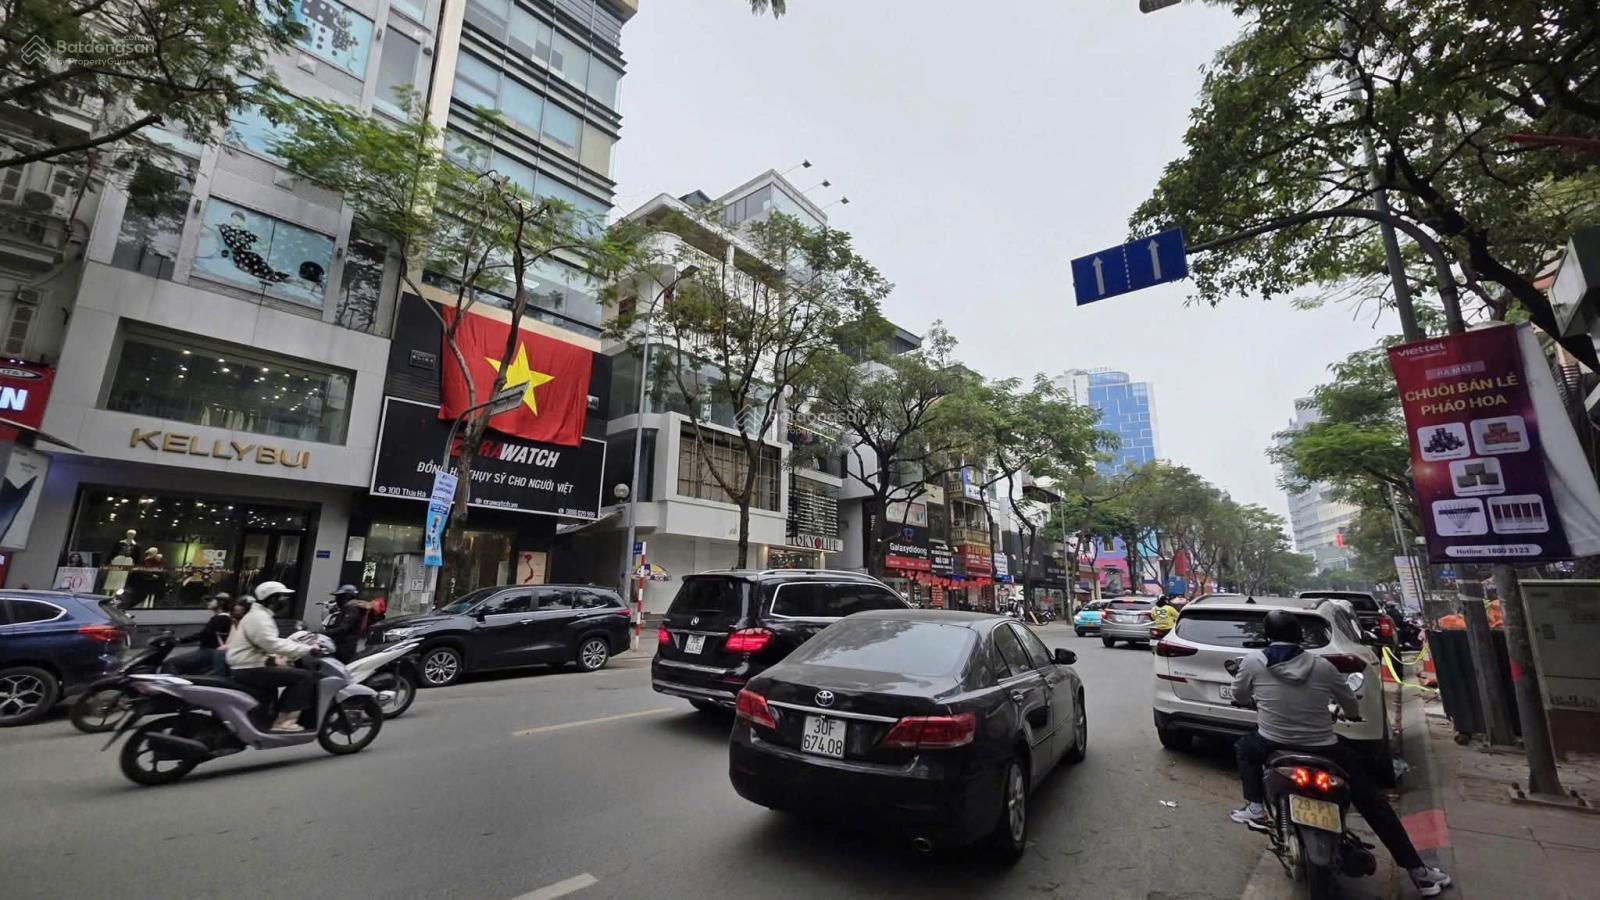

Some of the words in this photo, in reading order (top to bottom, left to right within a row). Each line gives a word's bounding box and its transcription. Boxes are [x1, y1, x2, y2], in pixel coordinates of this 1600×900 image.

[1398, 343, 1446, 357] viettel
[1421, 397, 1467, 416] PHÁO
[1470, 394, 1508, 408] HOA
[129, 428, 311, 469] KELLYBUI
[508, 475, 528, 487] CHO
[814, 718, 837, 736] 30F
[803, 734, 843, 756] 674.08
